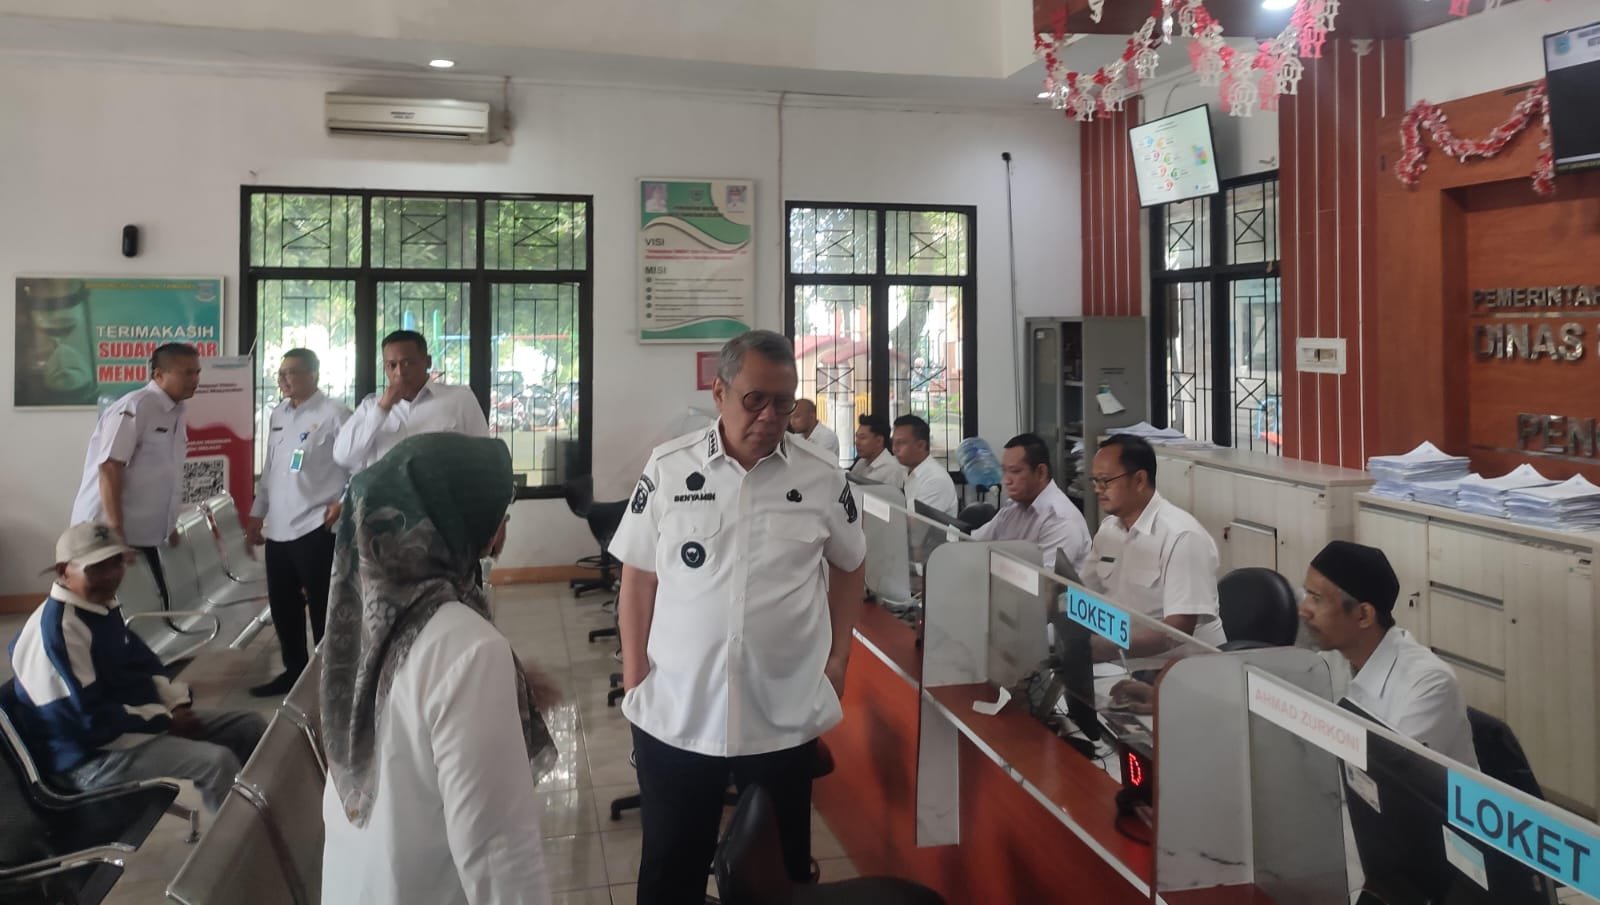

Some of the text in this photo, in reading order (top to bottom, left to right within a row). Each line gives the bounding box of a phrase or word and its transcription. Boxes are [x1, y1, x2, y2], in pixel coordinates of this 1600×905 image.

[645, 237, 664, 247] VISI
[645, 265, 667, 275] MISI
[96, 325, 214, 338] TERIMAKASIH
[1473, 321, 1585, 361] DINAS
[97, 365, 148, 382] MENU
[1516, 412, 1600, 457] PEN
[674, 492, 716, 502] BENYAMIN
[1070, 593, 1128, 644] LOKET 5
[1454, 784, 1592, 884] LOKET
